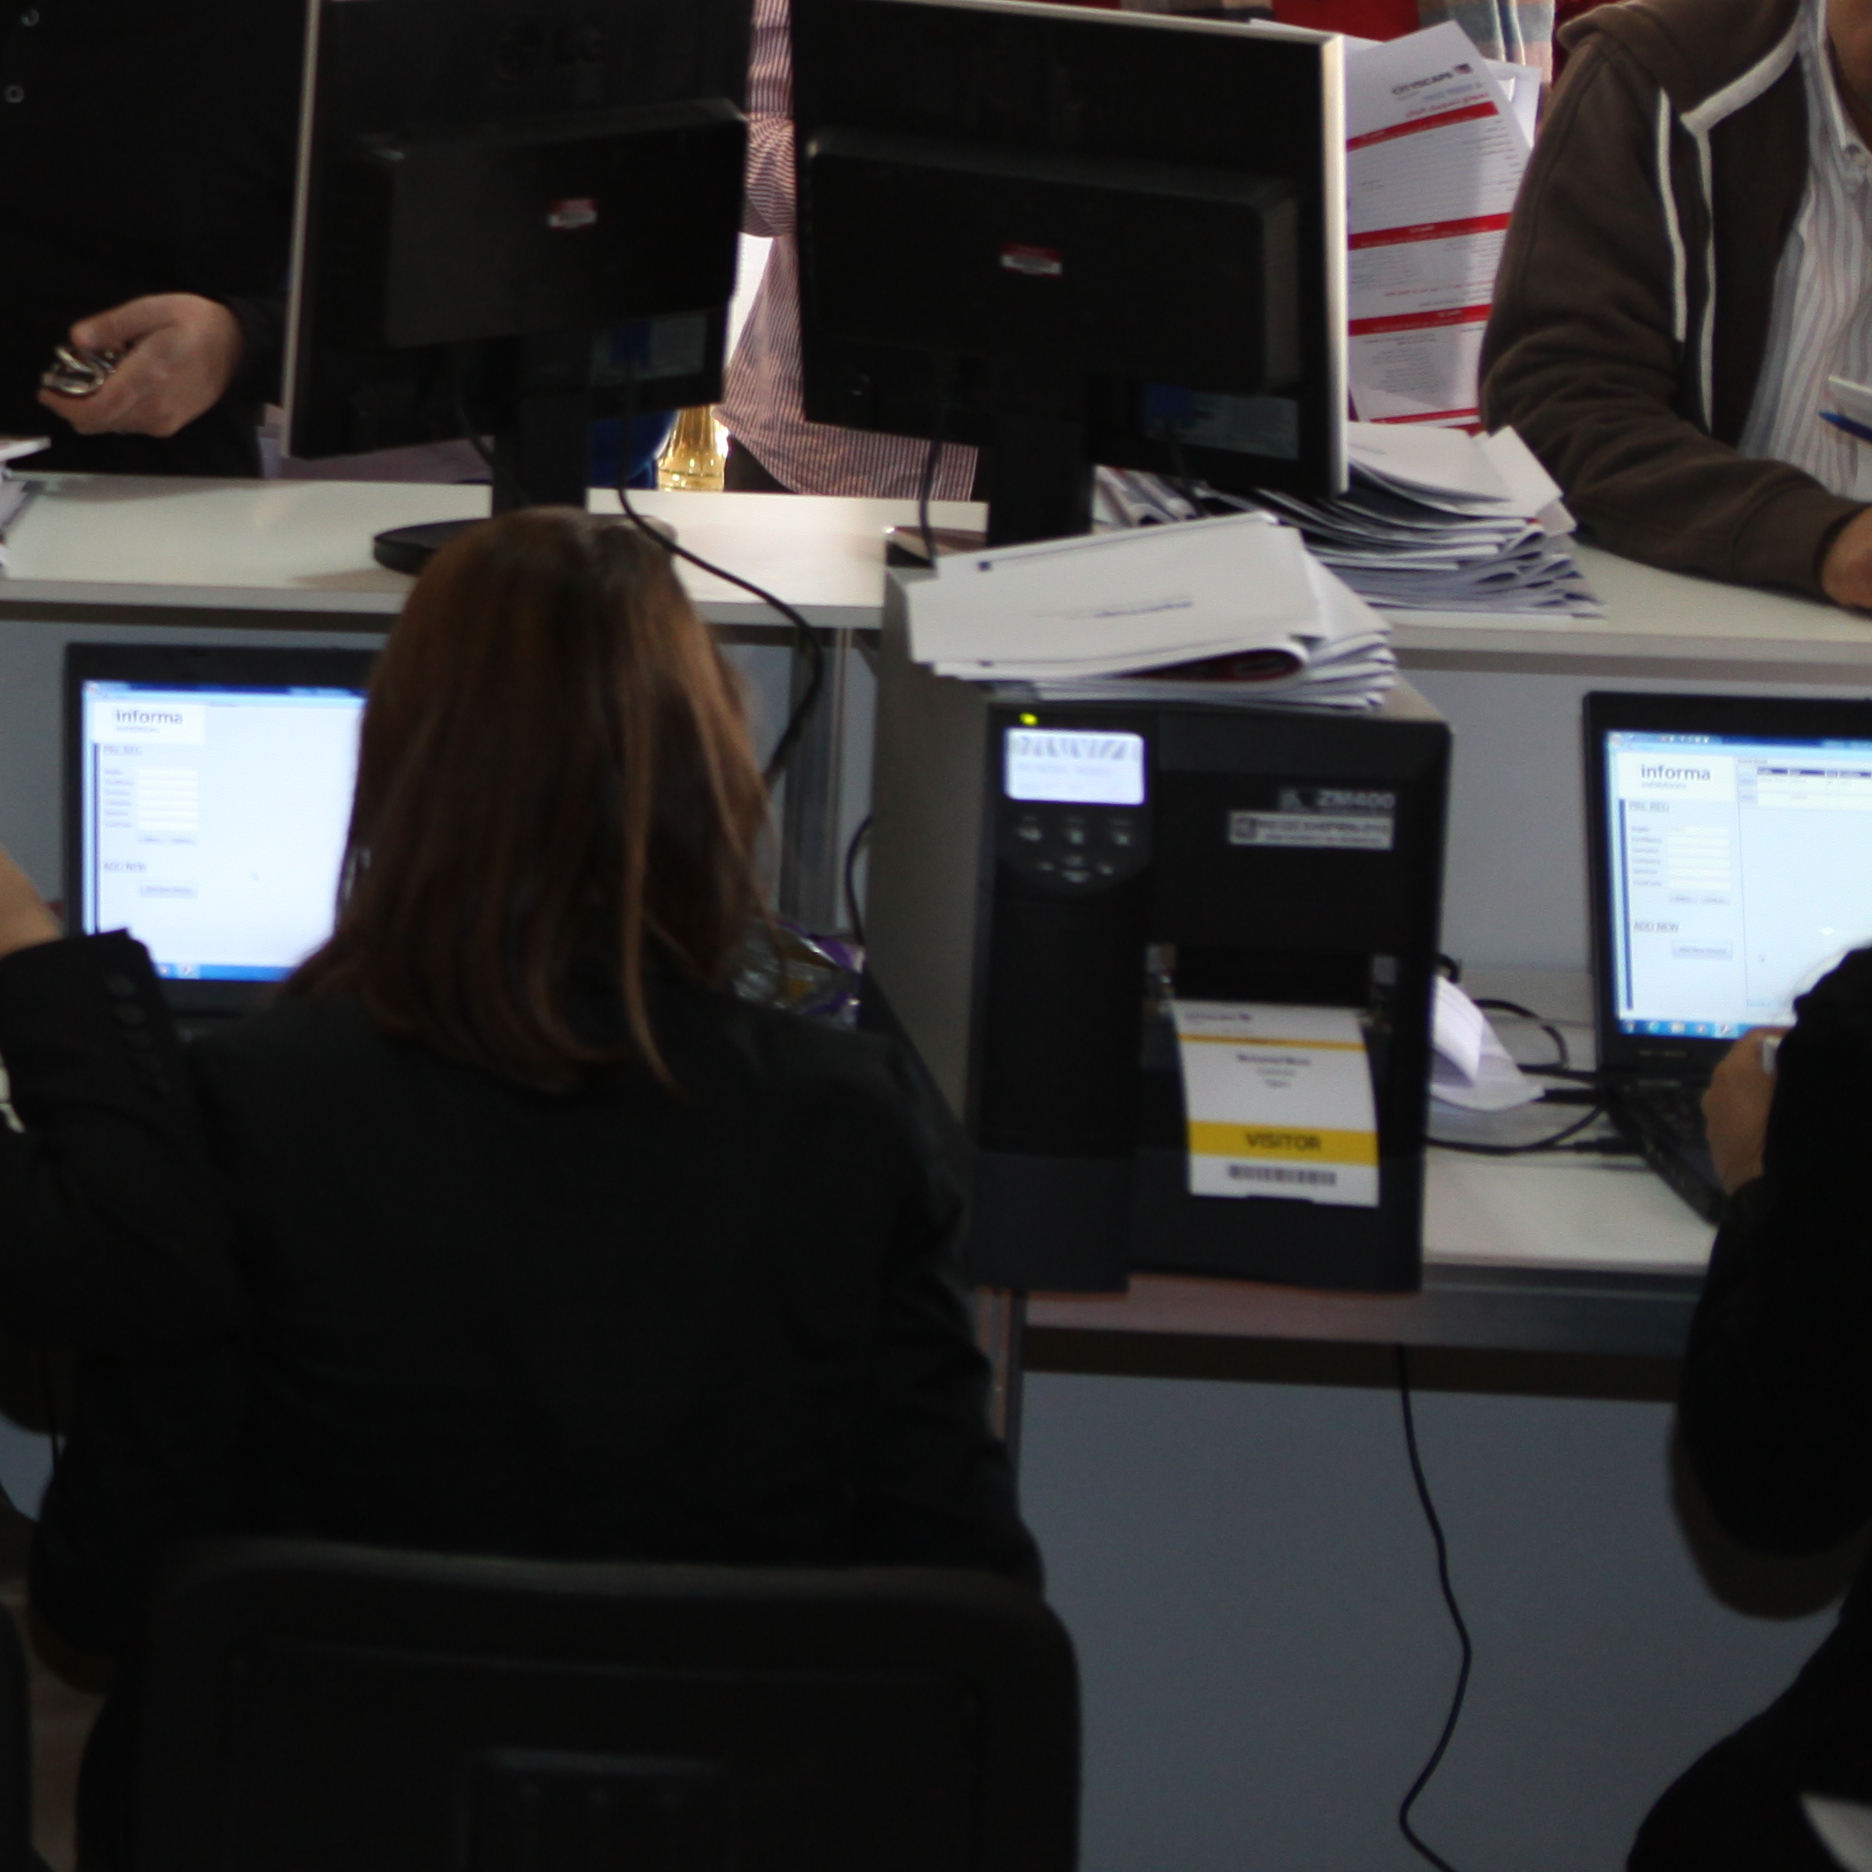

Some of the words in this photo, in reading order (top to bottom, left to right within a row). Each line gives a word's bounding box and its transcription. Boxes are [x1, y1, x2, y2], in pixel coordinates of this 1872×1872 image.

[116, 709, 184, 725] informa
[1640, 763, 1711, 783] informa
[1245, 1131, 1323, 1152] VISITOR
